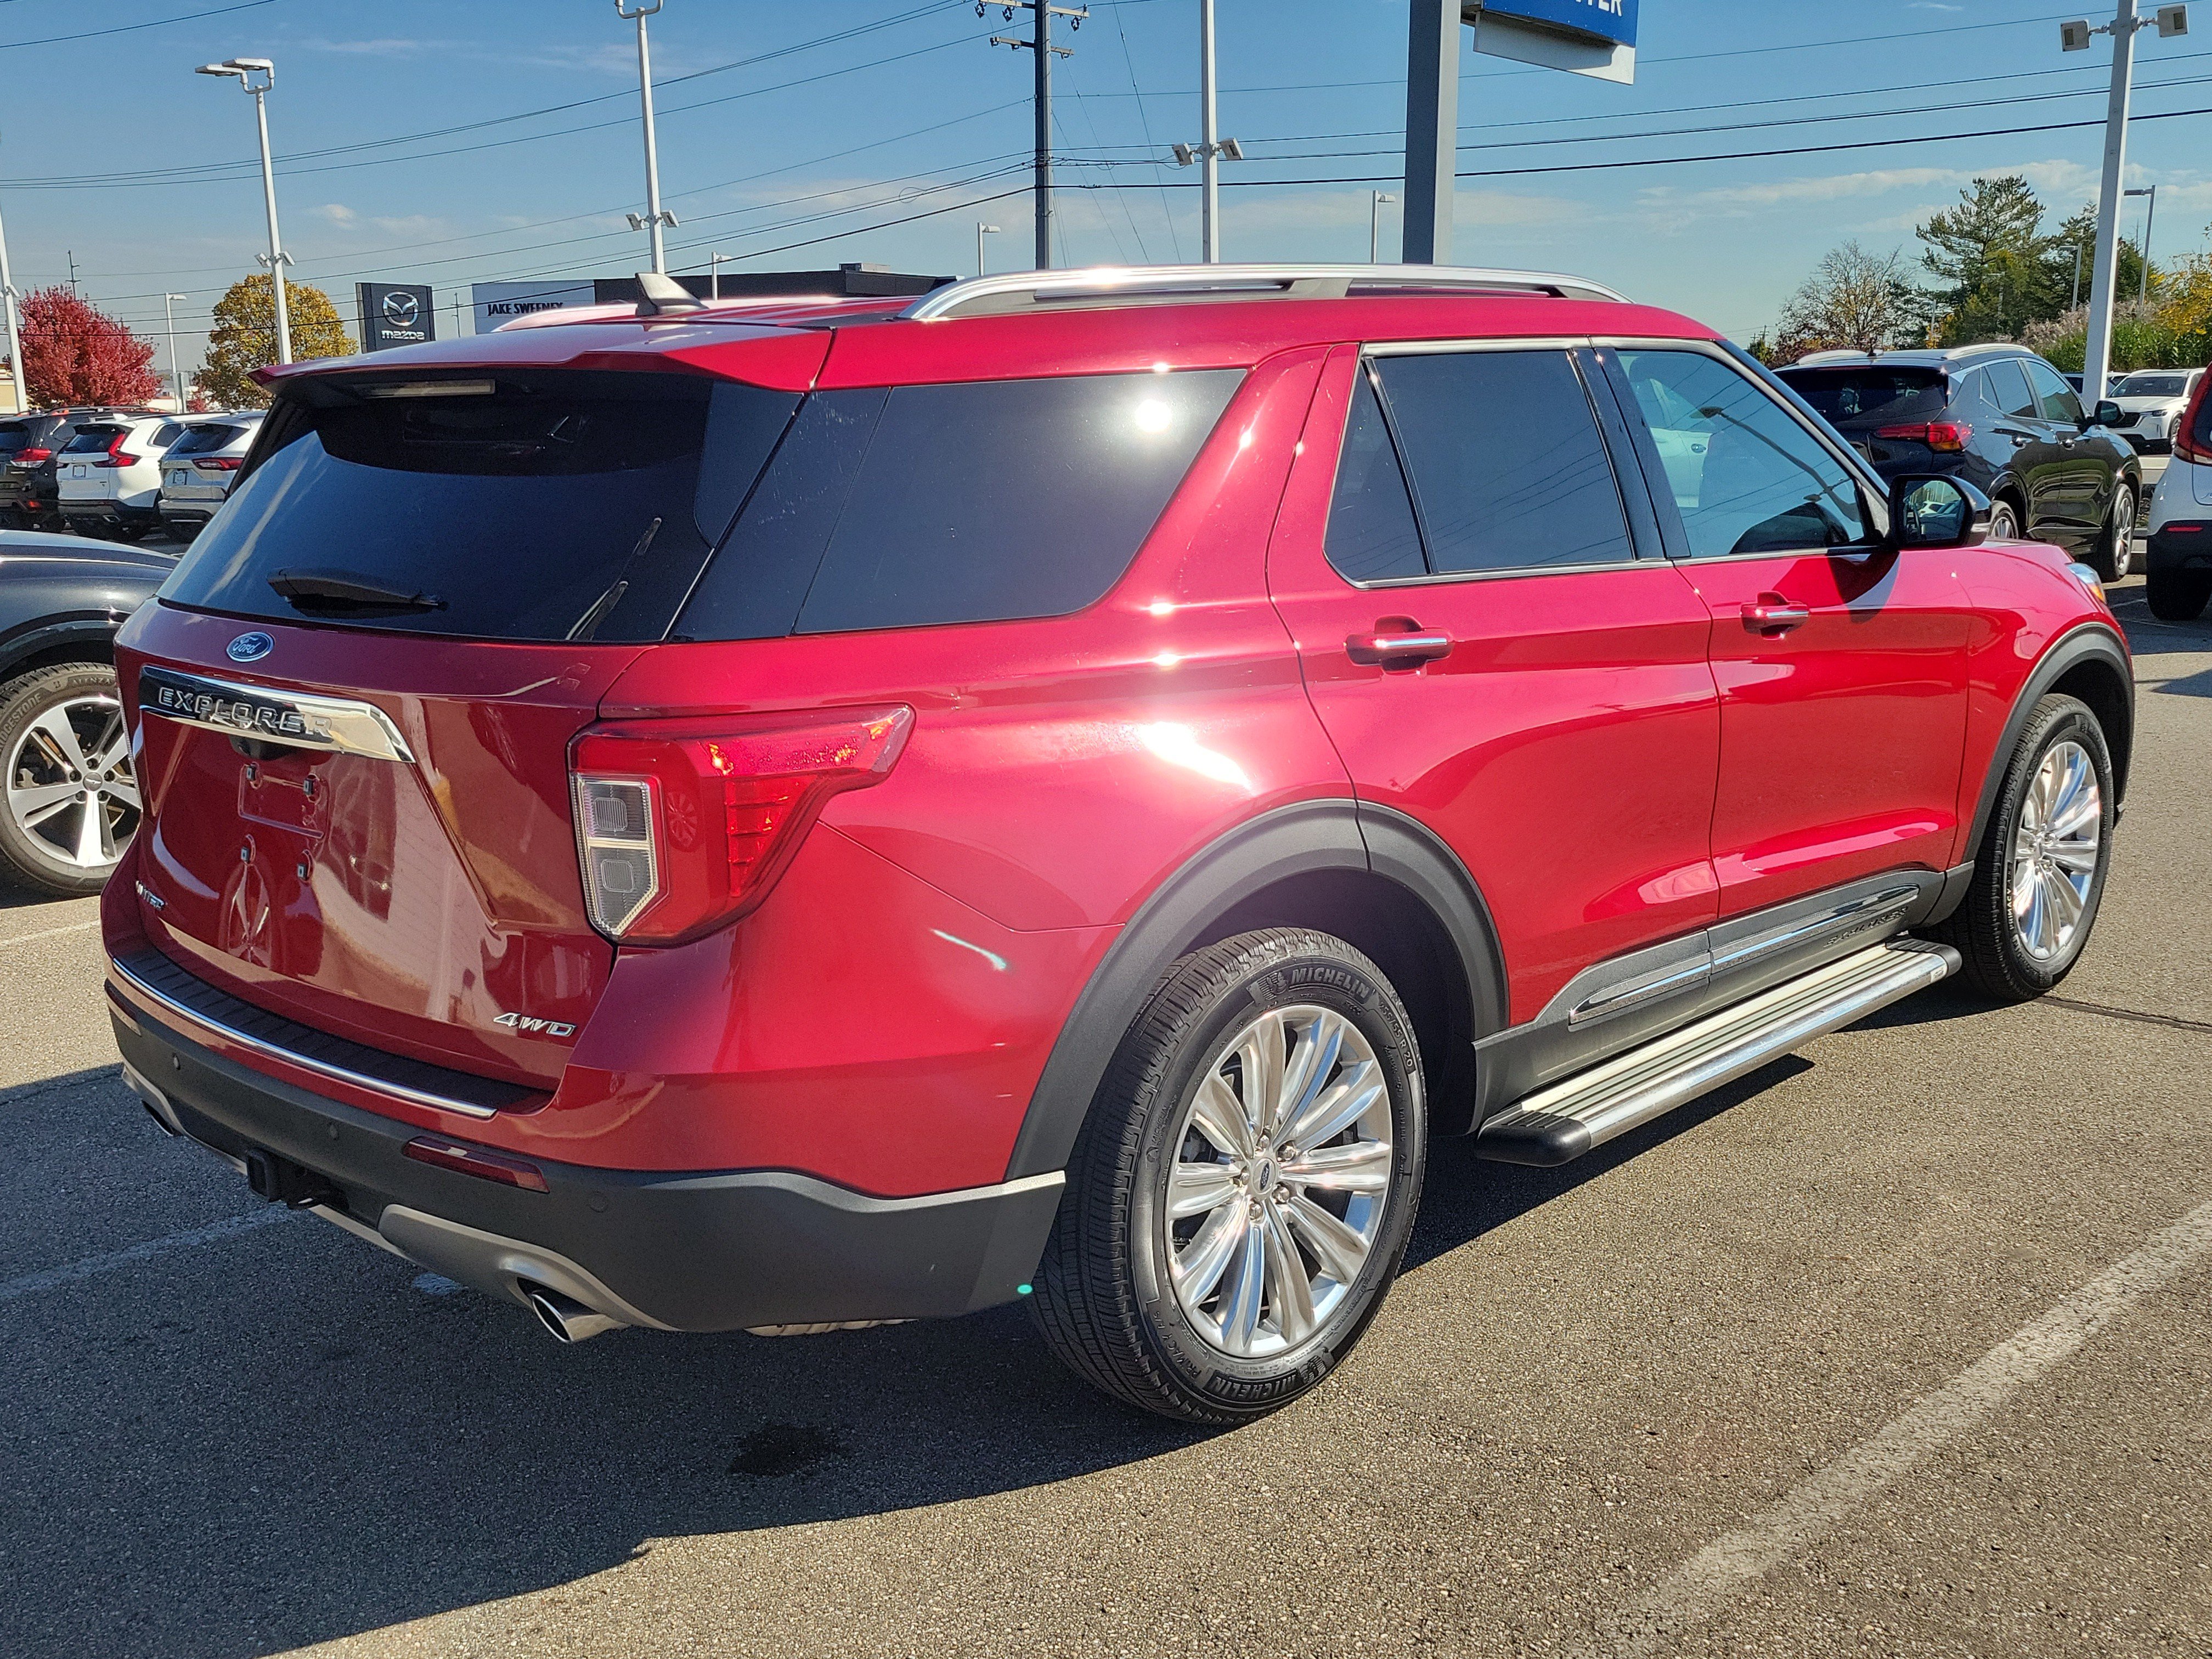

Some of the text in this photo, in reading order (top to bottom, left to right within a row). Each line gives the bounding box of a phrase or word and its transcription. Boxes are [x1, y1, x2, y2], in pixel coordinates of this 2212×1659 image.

[487, 302, 564, 317] JAKE SWEENEY
[158, 686, 334, 739] EXPLORER
[1290, 967, 1370, 1000] MICHELIN
[493, 1012, 577, 1037] 4WD
[1378, 1001, 1402, 1039] 255/55
[1399, 1039, 1407, 1049] R
[1403, 1051, 1414, 1068] 20
[1161, 1333, 1202, 1380] PRIMACY
[1215, 1374, 1297, 1399] MICHELIN
